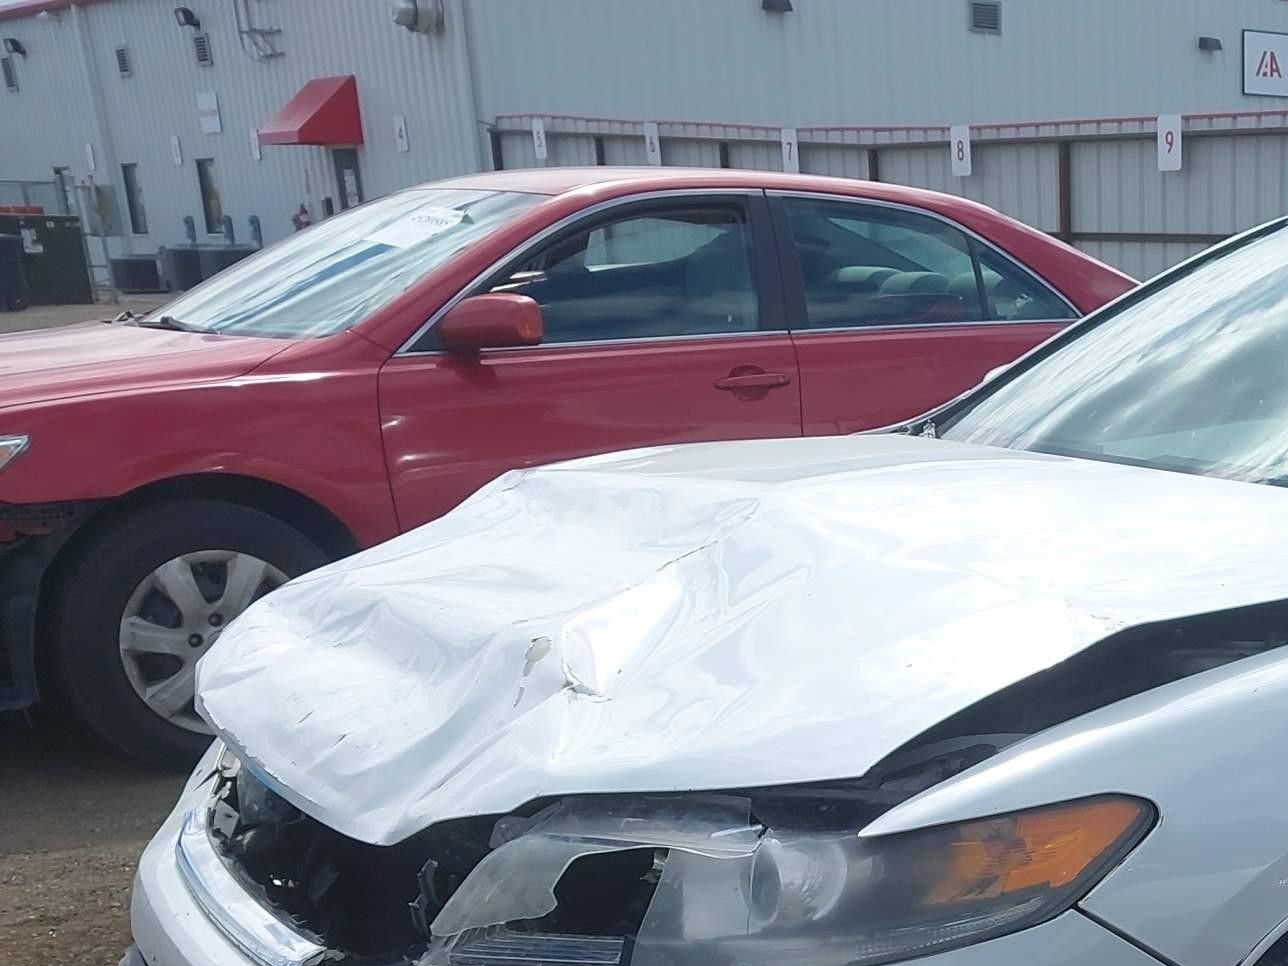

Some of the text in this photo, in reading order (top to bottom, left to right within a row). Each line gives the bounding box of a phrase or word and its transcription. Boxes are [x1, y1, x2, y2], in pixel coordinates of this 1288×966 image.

[785, 141, 793, 161] 7
[956, 139, 965, 161] 8
[1165, 130, 1174, 154] 9
